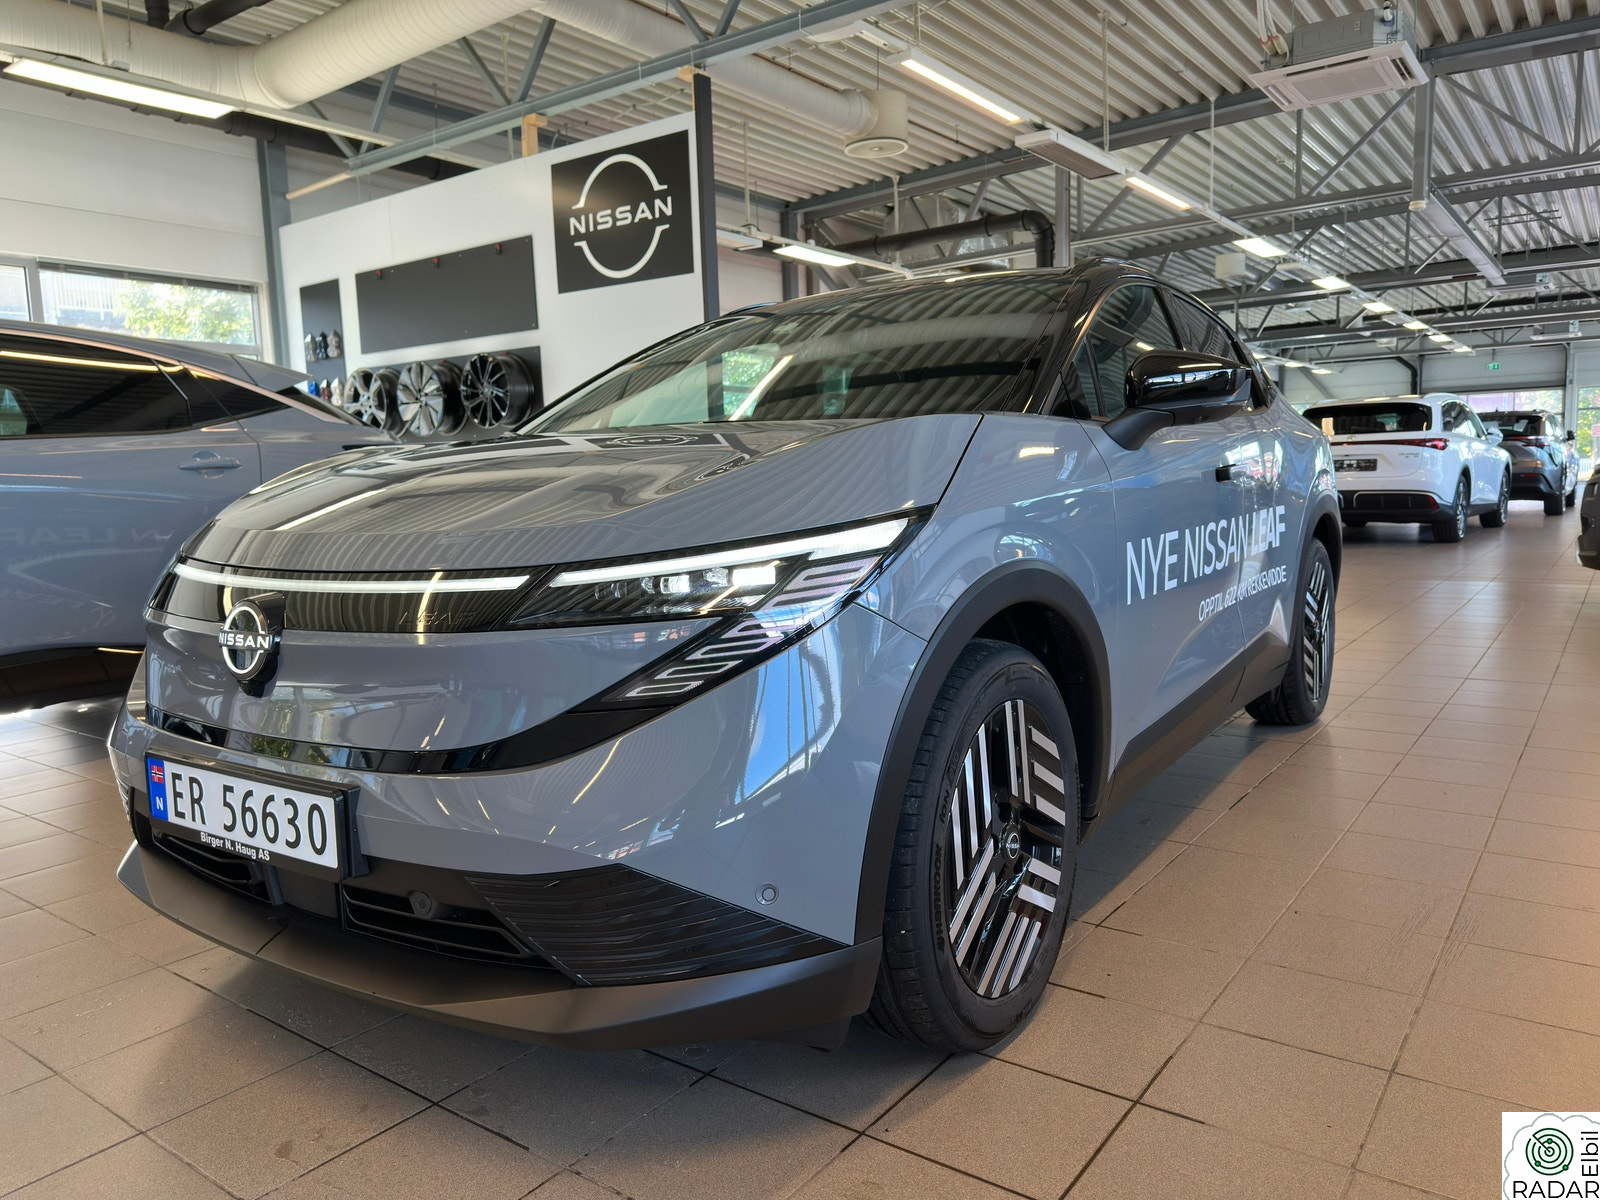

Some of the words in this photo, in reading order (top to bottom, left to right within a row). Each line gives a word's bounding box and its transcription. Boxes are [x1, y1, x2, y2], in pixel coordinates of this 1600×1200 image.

[569, 196, 672, 236] NISSAN
[1126, 530, 1179, 605] NYE
[1183, 513, 1250, 582] NISSAN
[1250, 505, 1286, 556] LEAF
[1224, 585, 1237, 609] 622
[1247, 565, 1287, 597] REKKEVIDDE
[218, 631, 270, 650] NISSAN
[155, 796, 164, 811] N
[171, 772, 206, 825] ER
[222, 784, 328, 856] 56630
[200, 831, 224, 848] Birger
[225, 838, 234, 851] N.
[235, 841, 257, 860] Haug
[258, 848, 270, 861] AS
